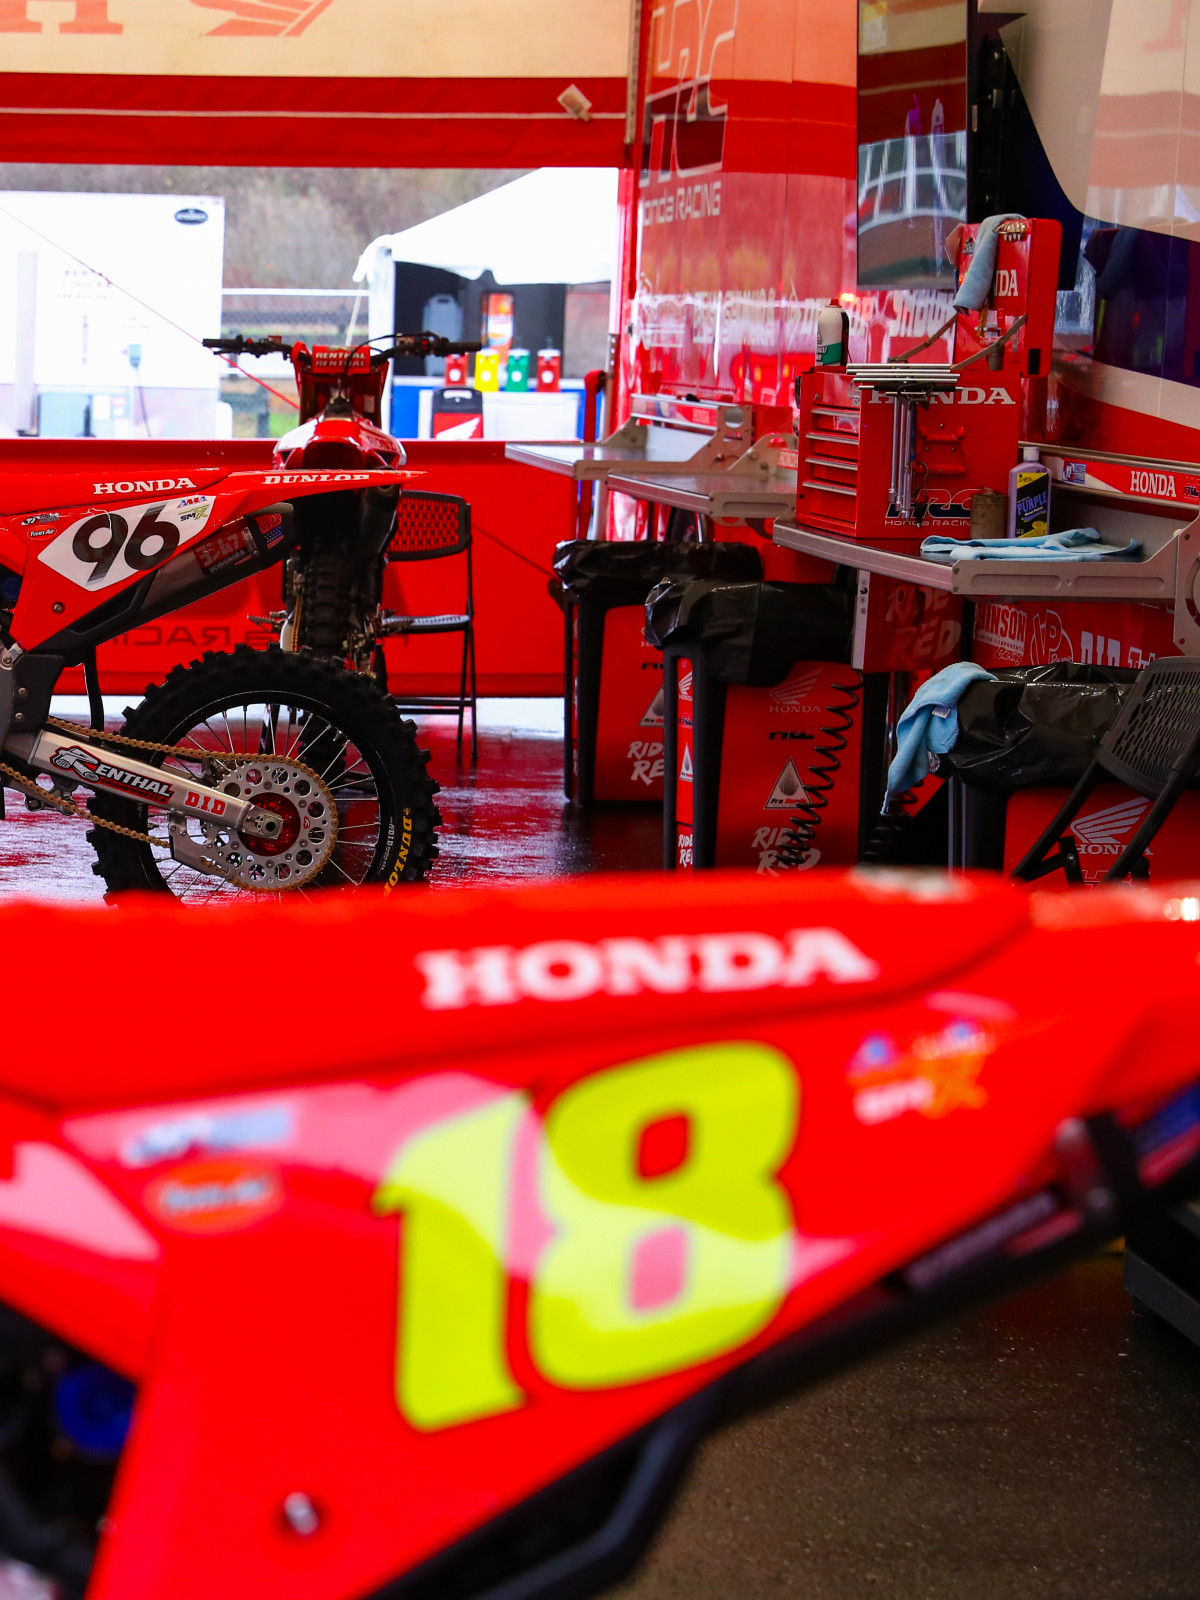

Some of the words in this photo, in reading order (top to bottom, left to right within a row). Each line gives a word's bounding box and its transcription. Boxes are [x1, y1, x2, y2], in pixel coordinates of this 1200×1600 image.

[675, 181, 722, 222] RACING
[868, 387, 1016, 405] HNDA
[93, 477, 197, 495] HONDA
[262, 474, 370, 485] DUNLOP
[1130, 470, 1177, 498] HONDA
[1017, 491, 1048, 516] PURPLE
[72, 502, 181, 588] 96
[769, 705, 822, 713] HONDA
[627, 740, 664, 761] RID
[52, 746, 172, 798] RENTHAL
[631, 760, 664, 786] RE
[416, 928, 876, 1010] HONDA
[372, 1040, 799, 1432] 18
